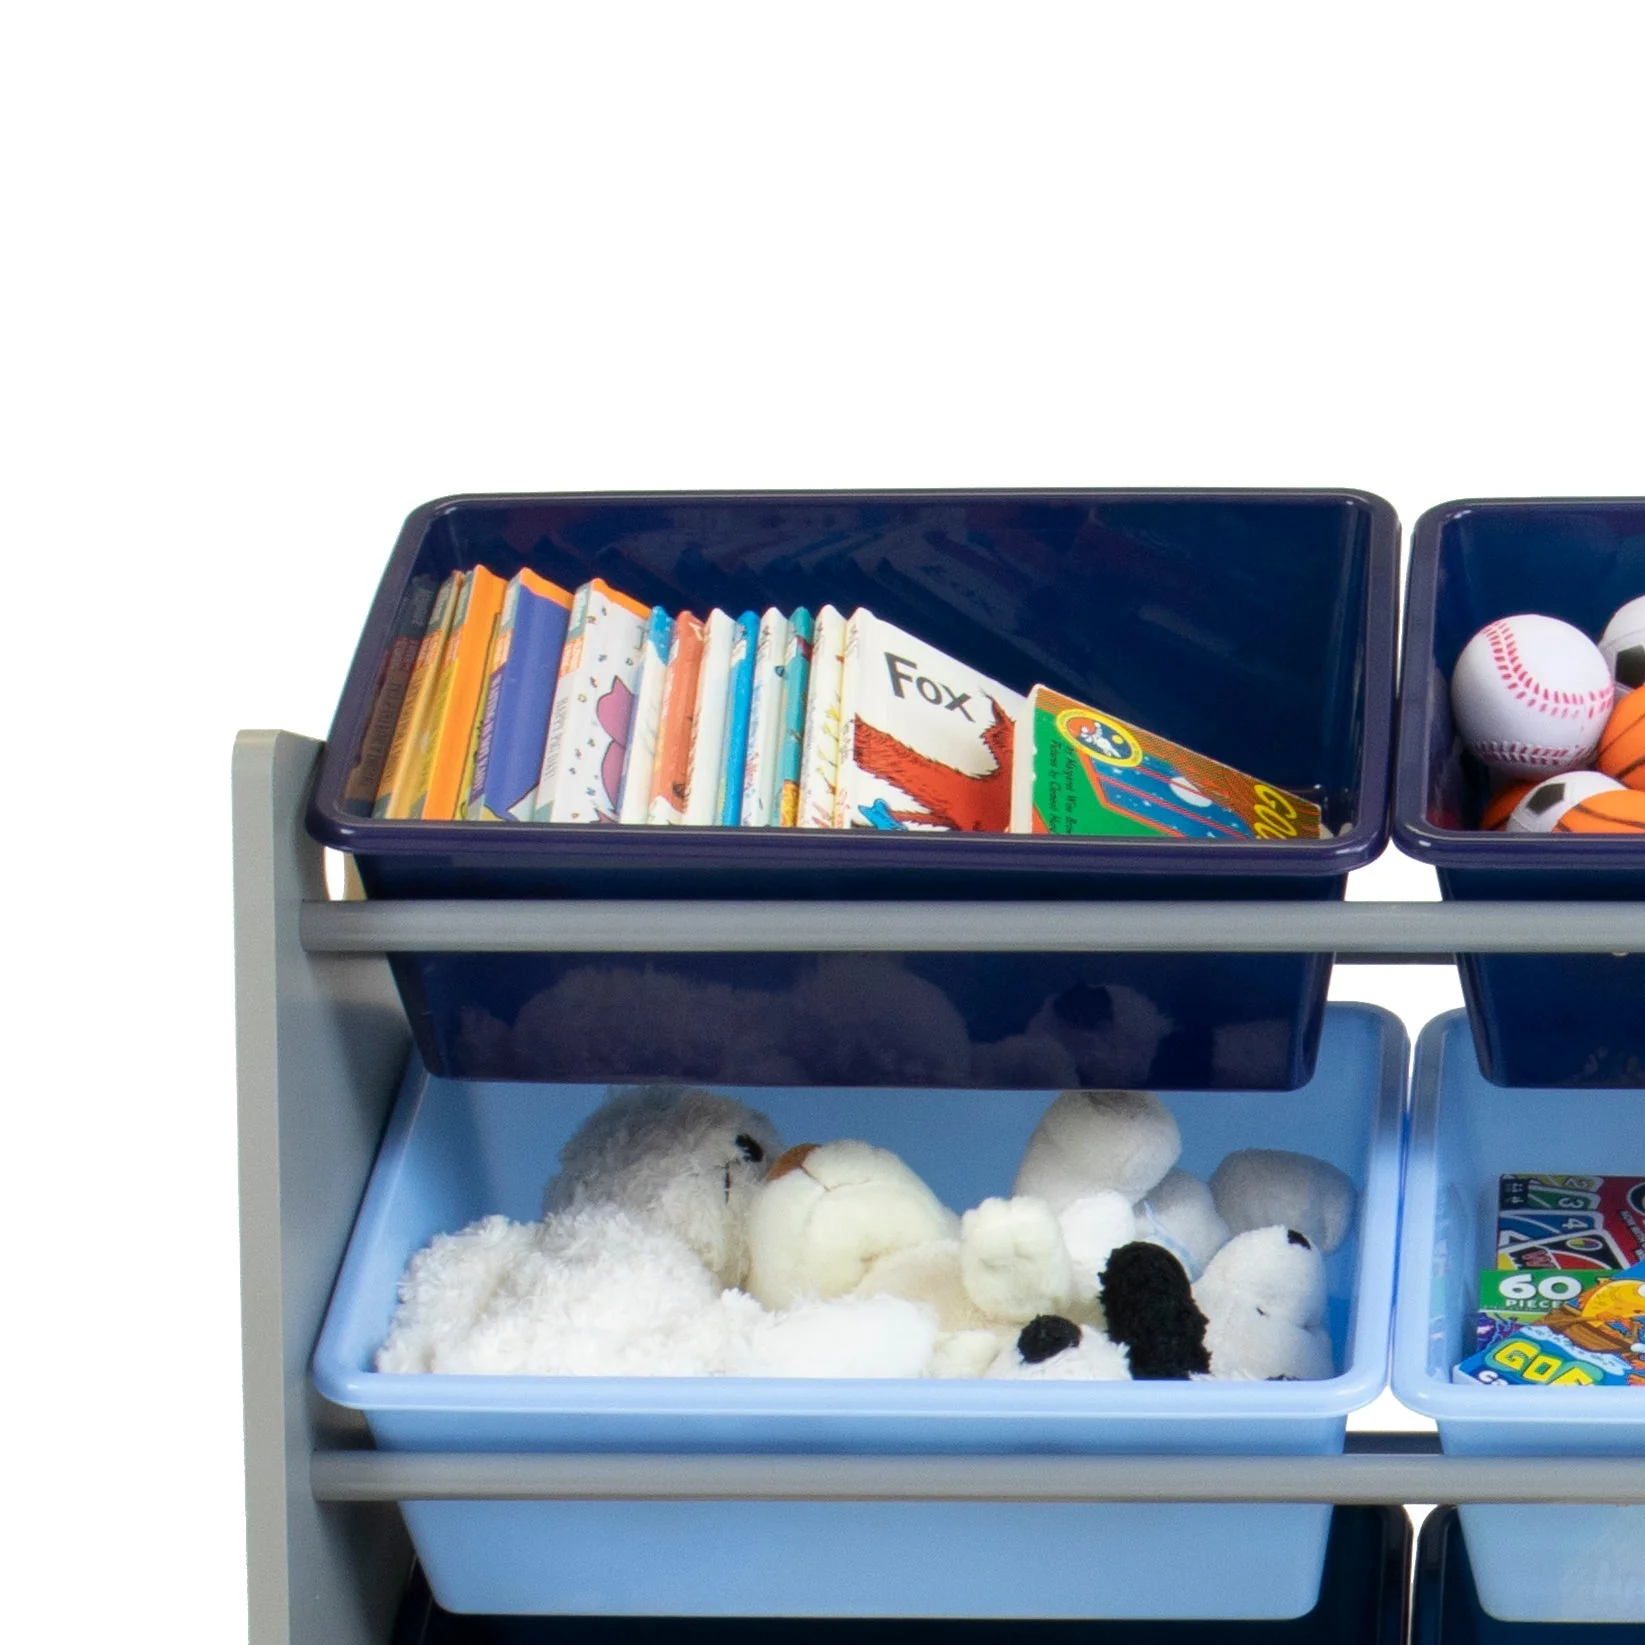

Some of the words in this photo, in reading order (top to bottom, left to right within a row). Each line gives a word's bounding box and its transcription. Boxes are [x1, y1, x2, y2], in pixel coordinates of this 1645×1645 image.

[1558, 1197, 1585, 1209] 3
[1561, 1217, 1589, 1230] 4
[1499, 1273, 1582, 1301] 60
[1505, 1299, 1562, 1309] PIECE
